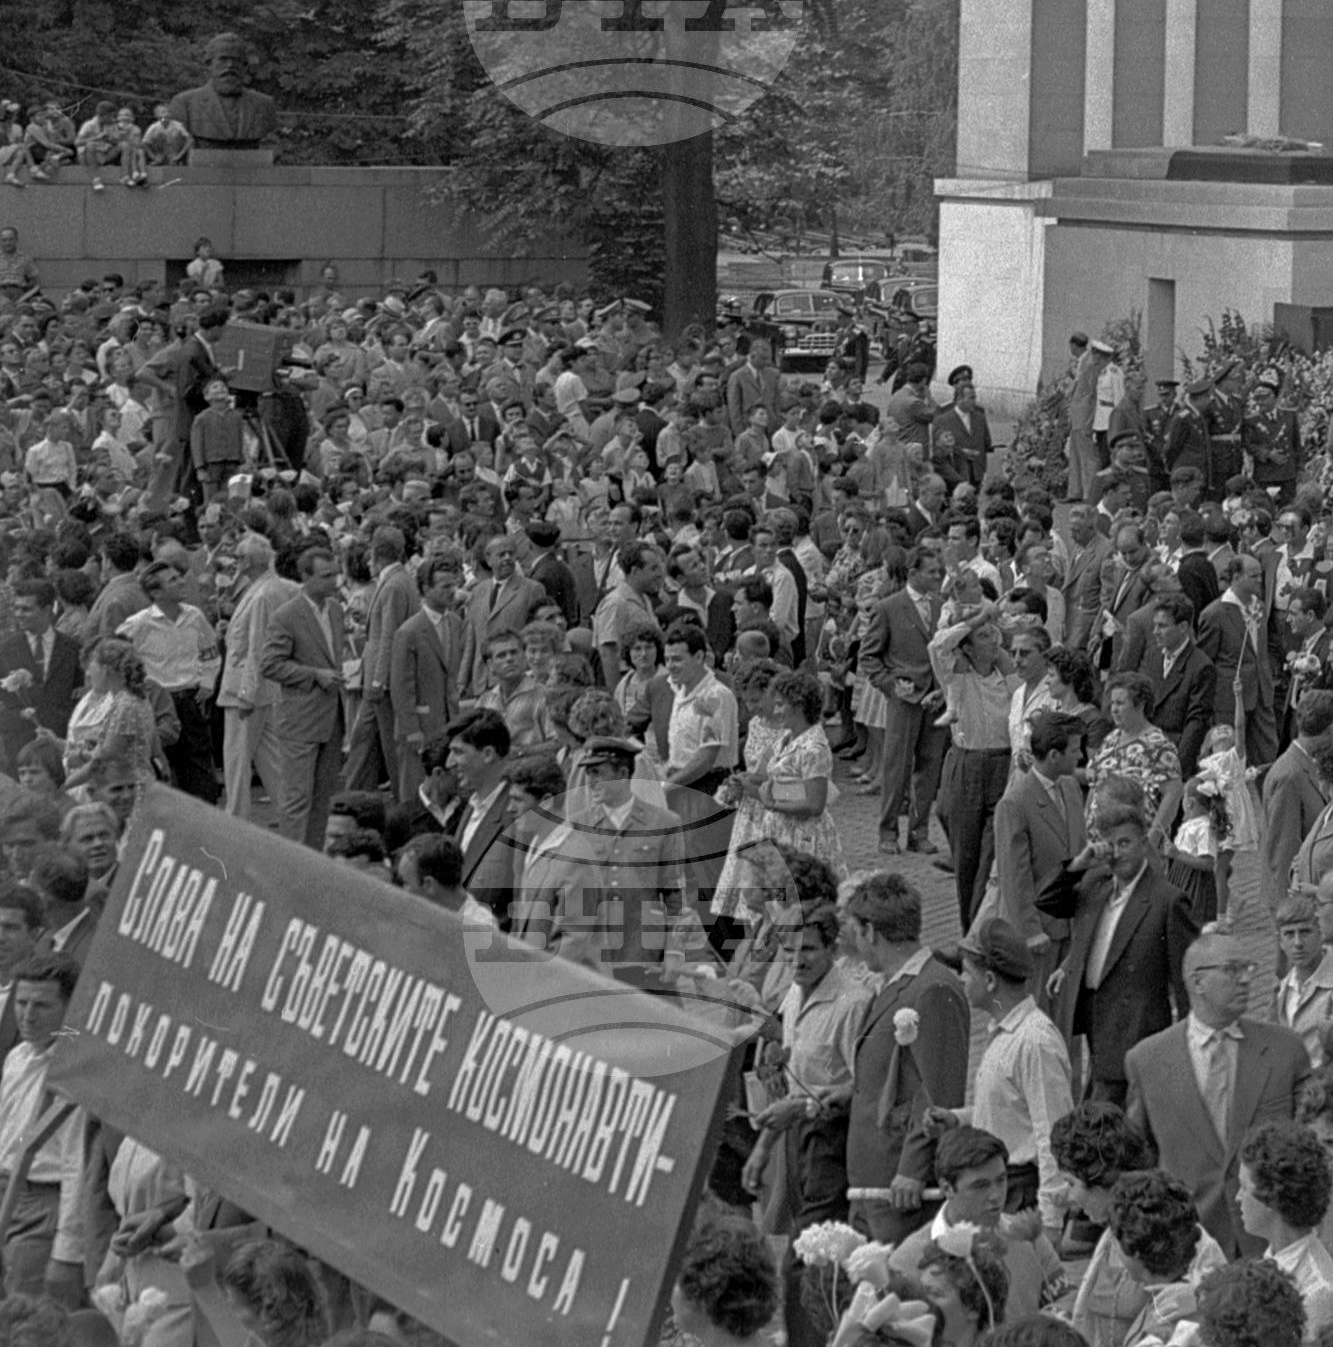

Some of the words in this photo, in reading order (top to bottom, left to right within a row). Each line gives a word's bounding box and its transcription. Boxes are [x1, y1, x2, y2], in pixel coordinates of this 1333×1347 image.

[117, 828, 219, 969] СЛАВА
[207, 892, 267, 993] НА
[261, 917, 463, 1097] СЪВЕТСКИТЕ
[84, 980, 306, 1148] ПОКОРИТЕЛИ
[314, 1109, 371, 1190] НА
